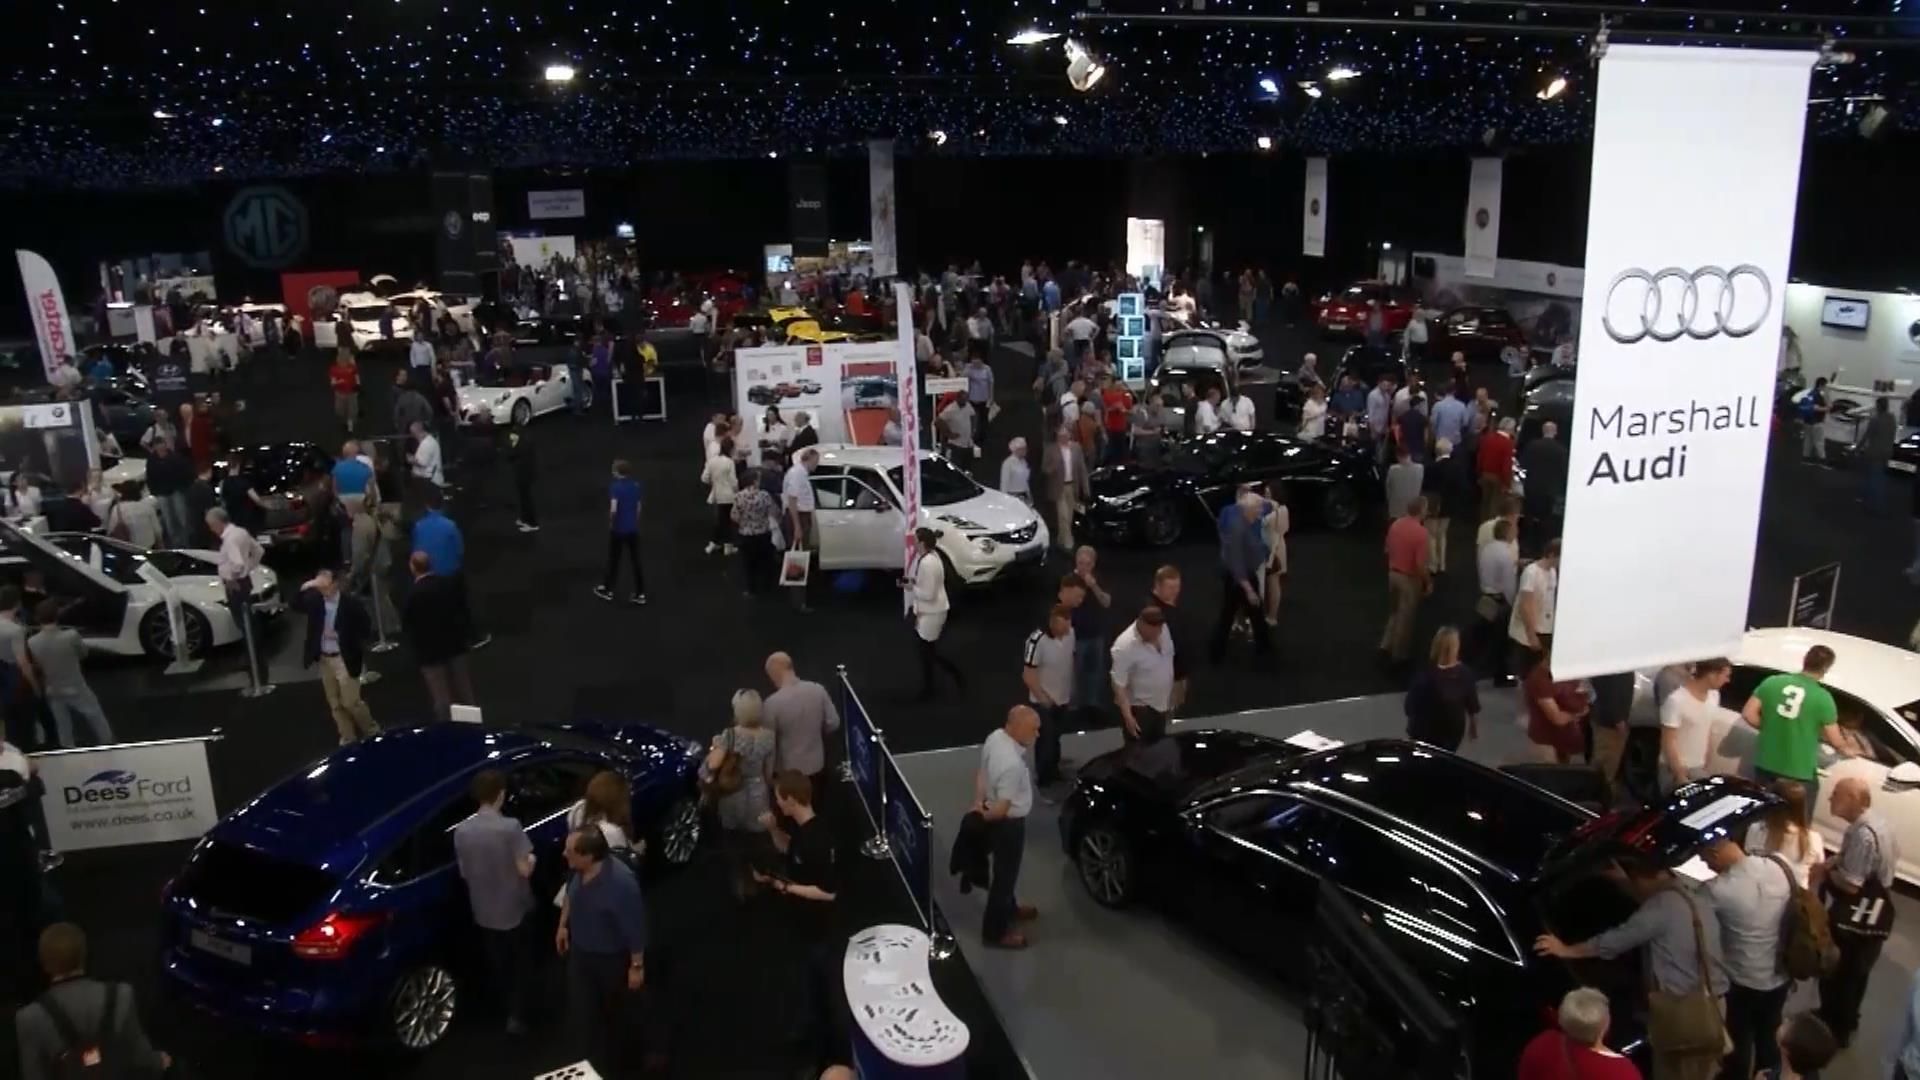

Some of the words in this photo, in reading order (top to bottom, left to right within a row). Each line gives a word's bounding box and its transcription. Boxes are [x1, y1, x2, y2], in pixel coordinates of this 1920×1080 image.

[471, 211, 491, 223] eep
[795, 198, 822, 210] Jeep
[233, 197, 298, 258] MG
[1590, 395, 1760, 441] Marshall
[1586, 445, 1688, 486] Audi
[1776, 684, 1806, 720] 3
[63, 785, 131, 805] Dees
[136, 775, 192, 798] Ford
[69, 807, 196, 831] www.dees.co.uk
